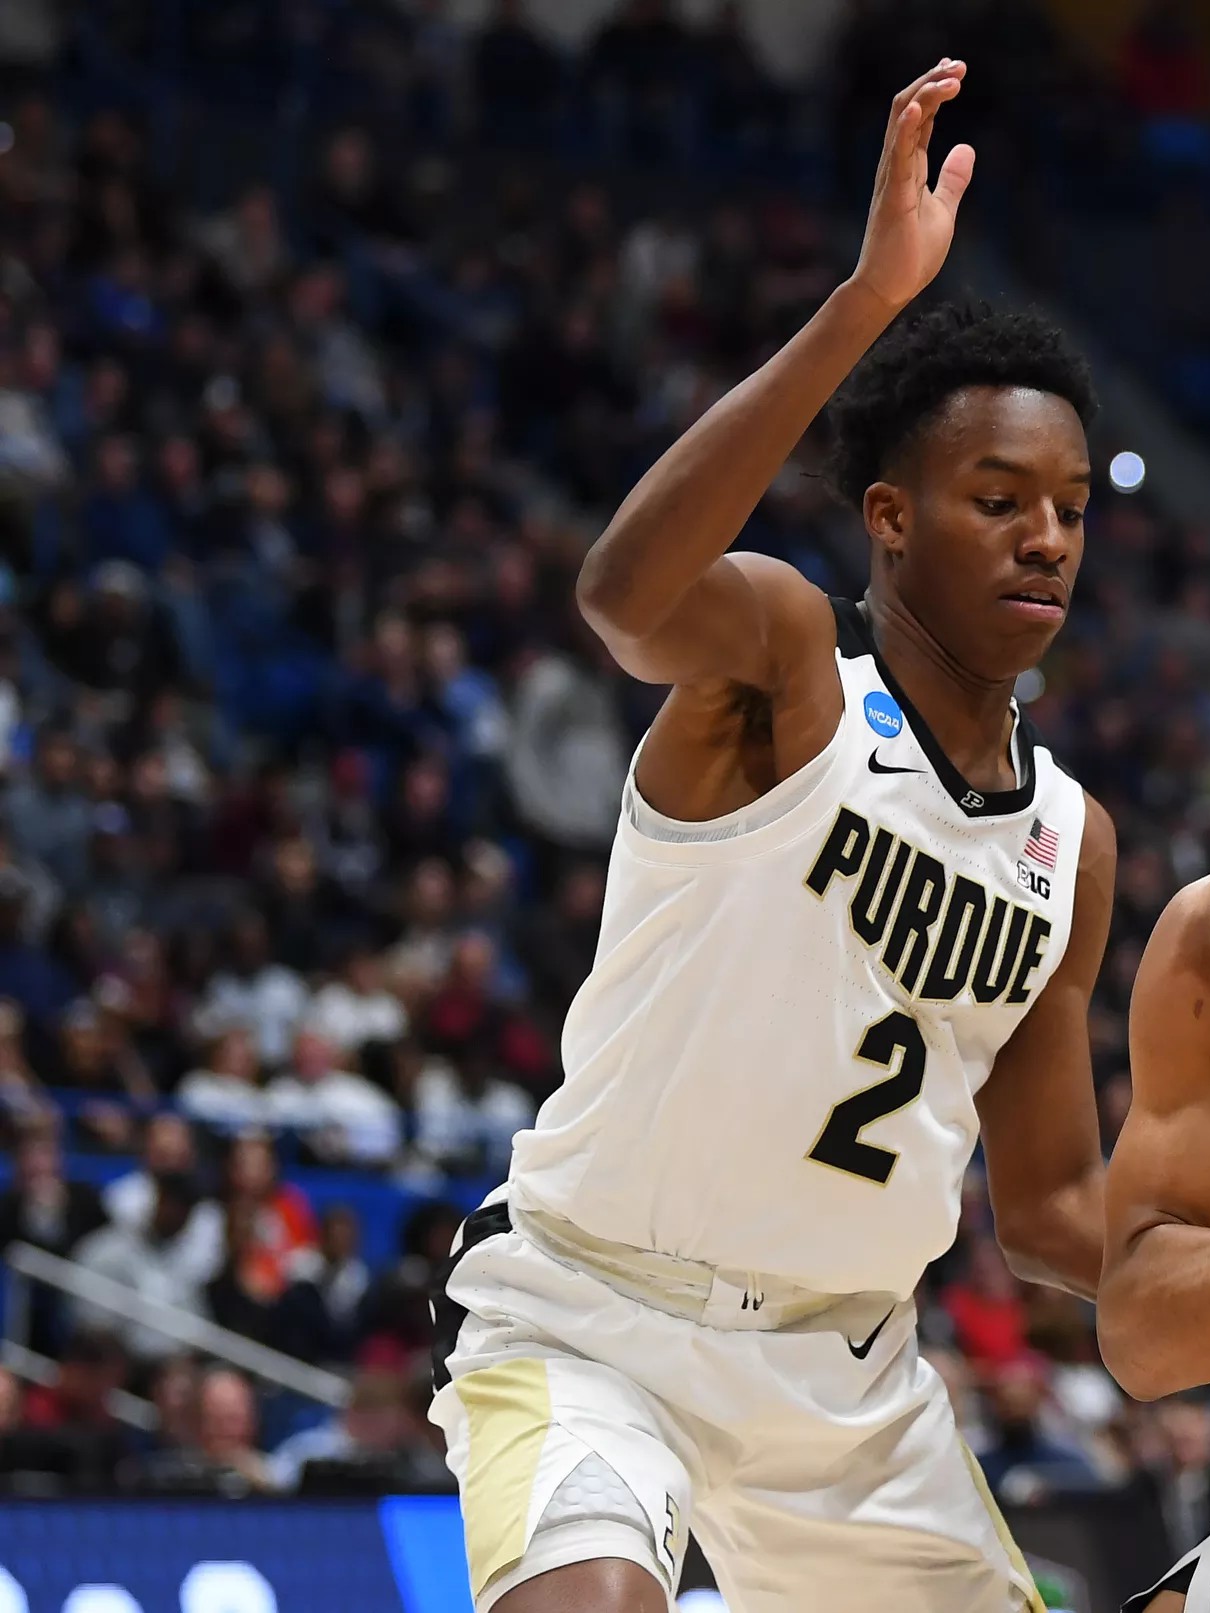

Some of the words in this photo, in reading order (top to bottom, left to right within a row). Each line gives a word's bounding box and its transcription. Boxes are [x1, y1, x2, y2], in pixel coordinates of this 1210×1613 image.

[867, 706, 900, 730] NCAA
[803, 803, 1052, 1006] PURDUE
[804, 1009, 927, 1188] 2
